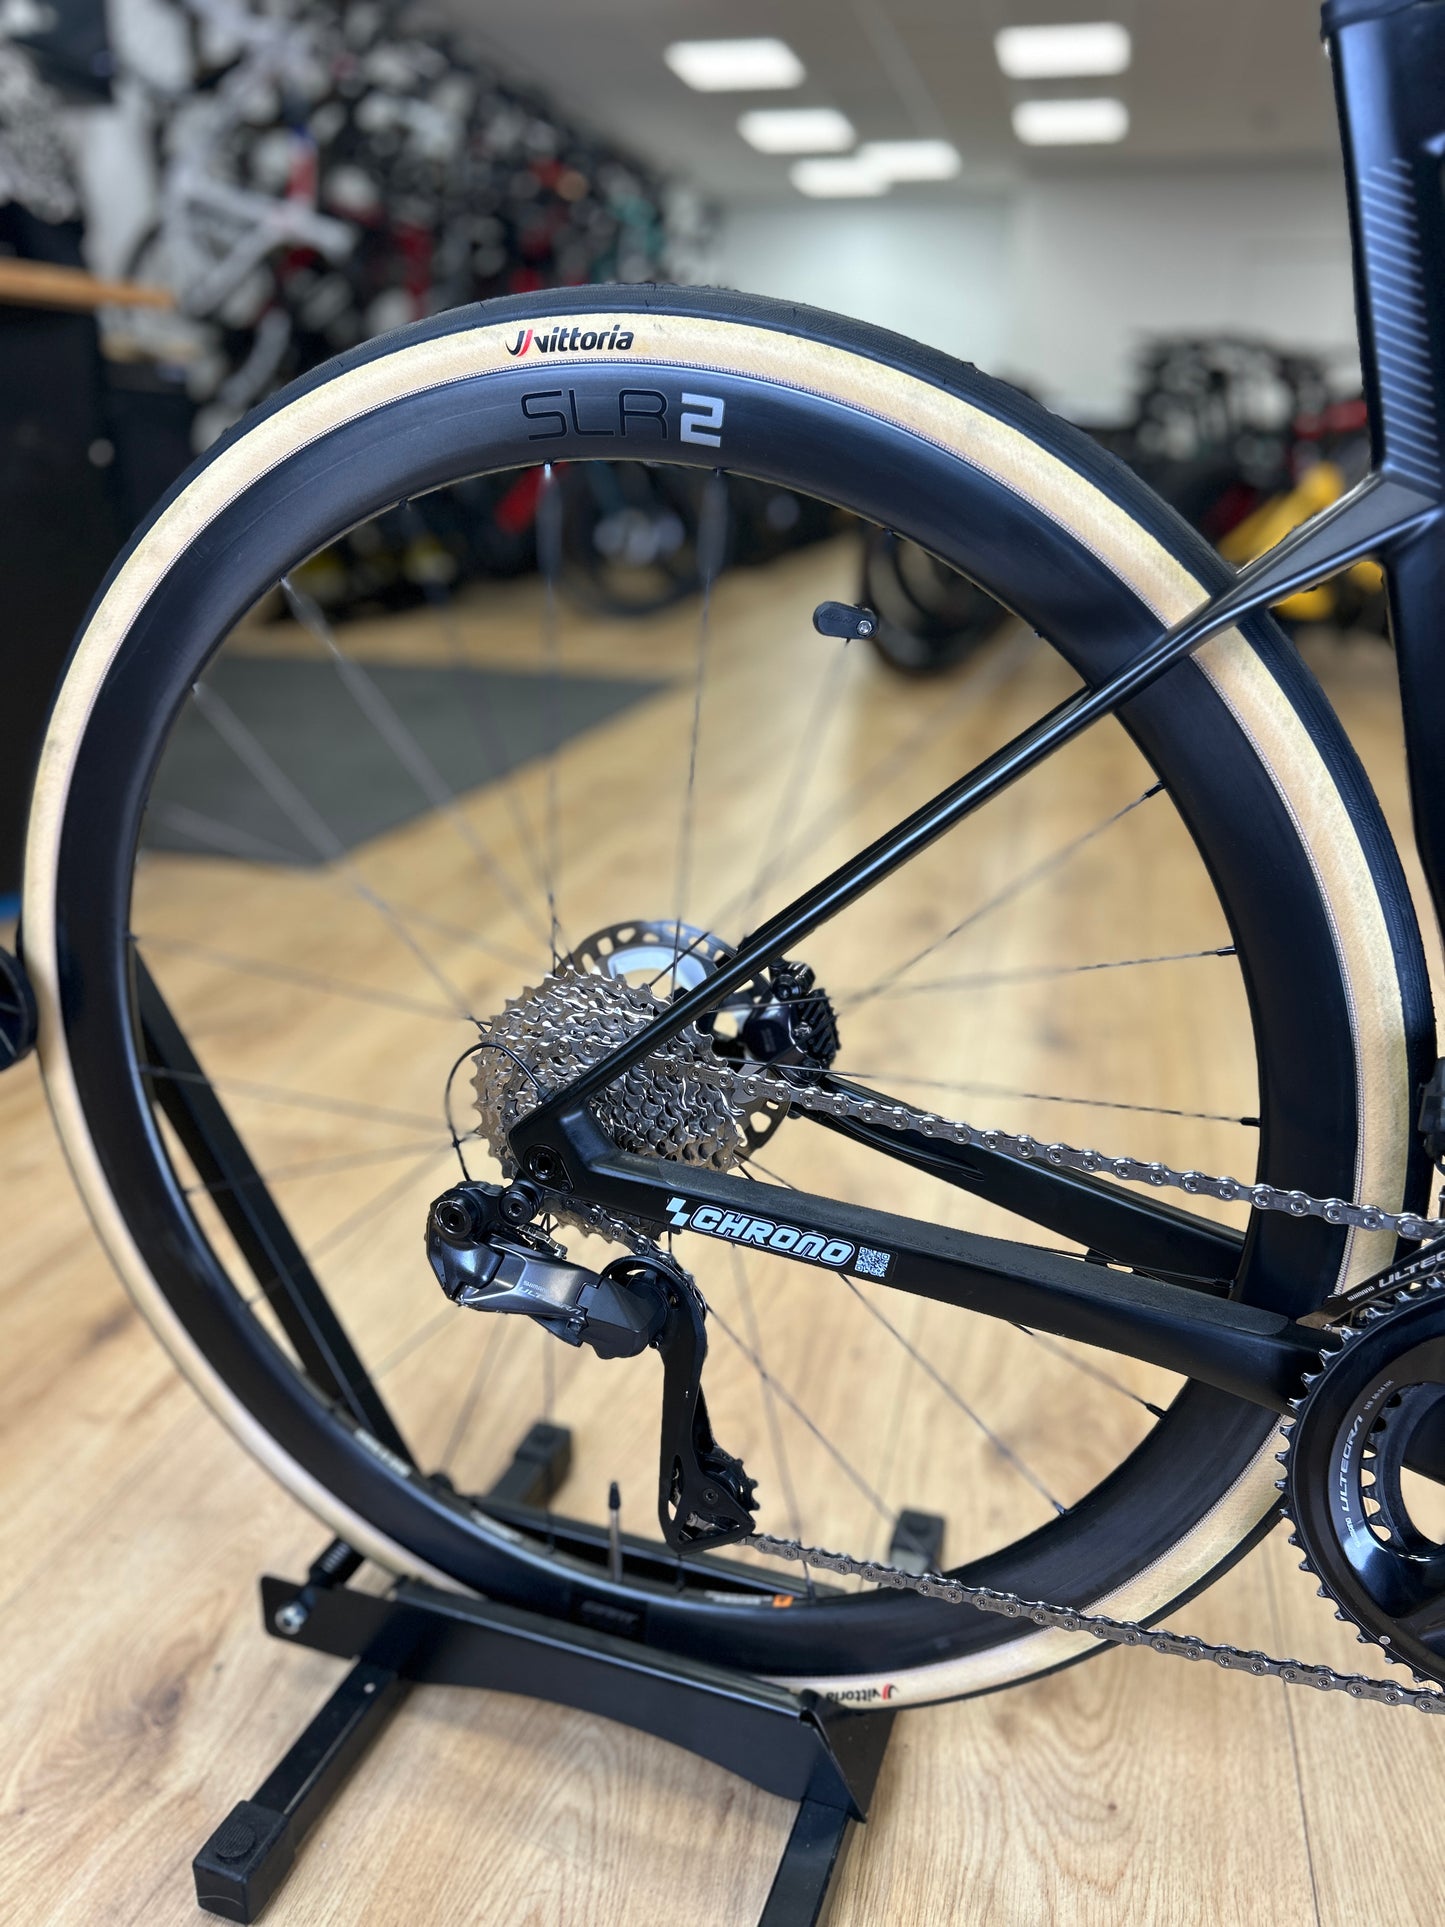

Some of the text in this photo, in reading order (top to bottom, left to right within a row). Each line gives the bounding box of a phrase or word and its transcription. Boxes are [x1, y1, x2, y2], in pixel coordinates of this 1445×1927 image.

[533, 324, 635, 354] vittoria
[520, 388, 725, 448] SLR 2
[690, 1204, 856, 1266] CHRONO
[518, 1286, 582, 1315] ULTRA
[1338, 1414, 1364, 1512] ULTEGRA
